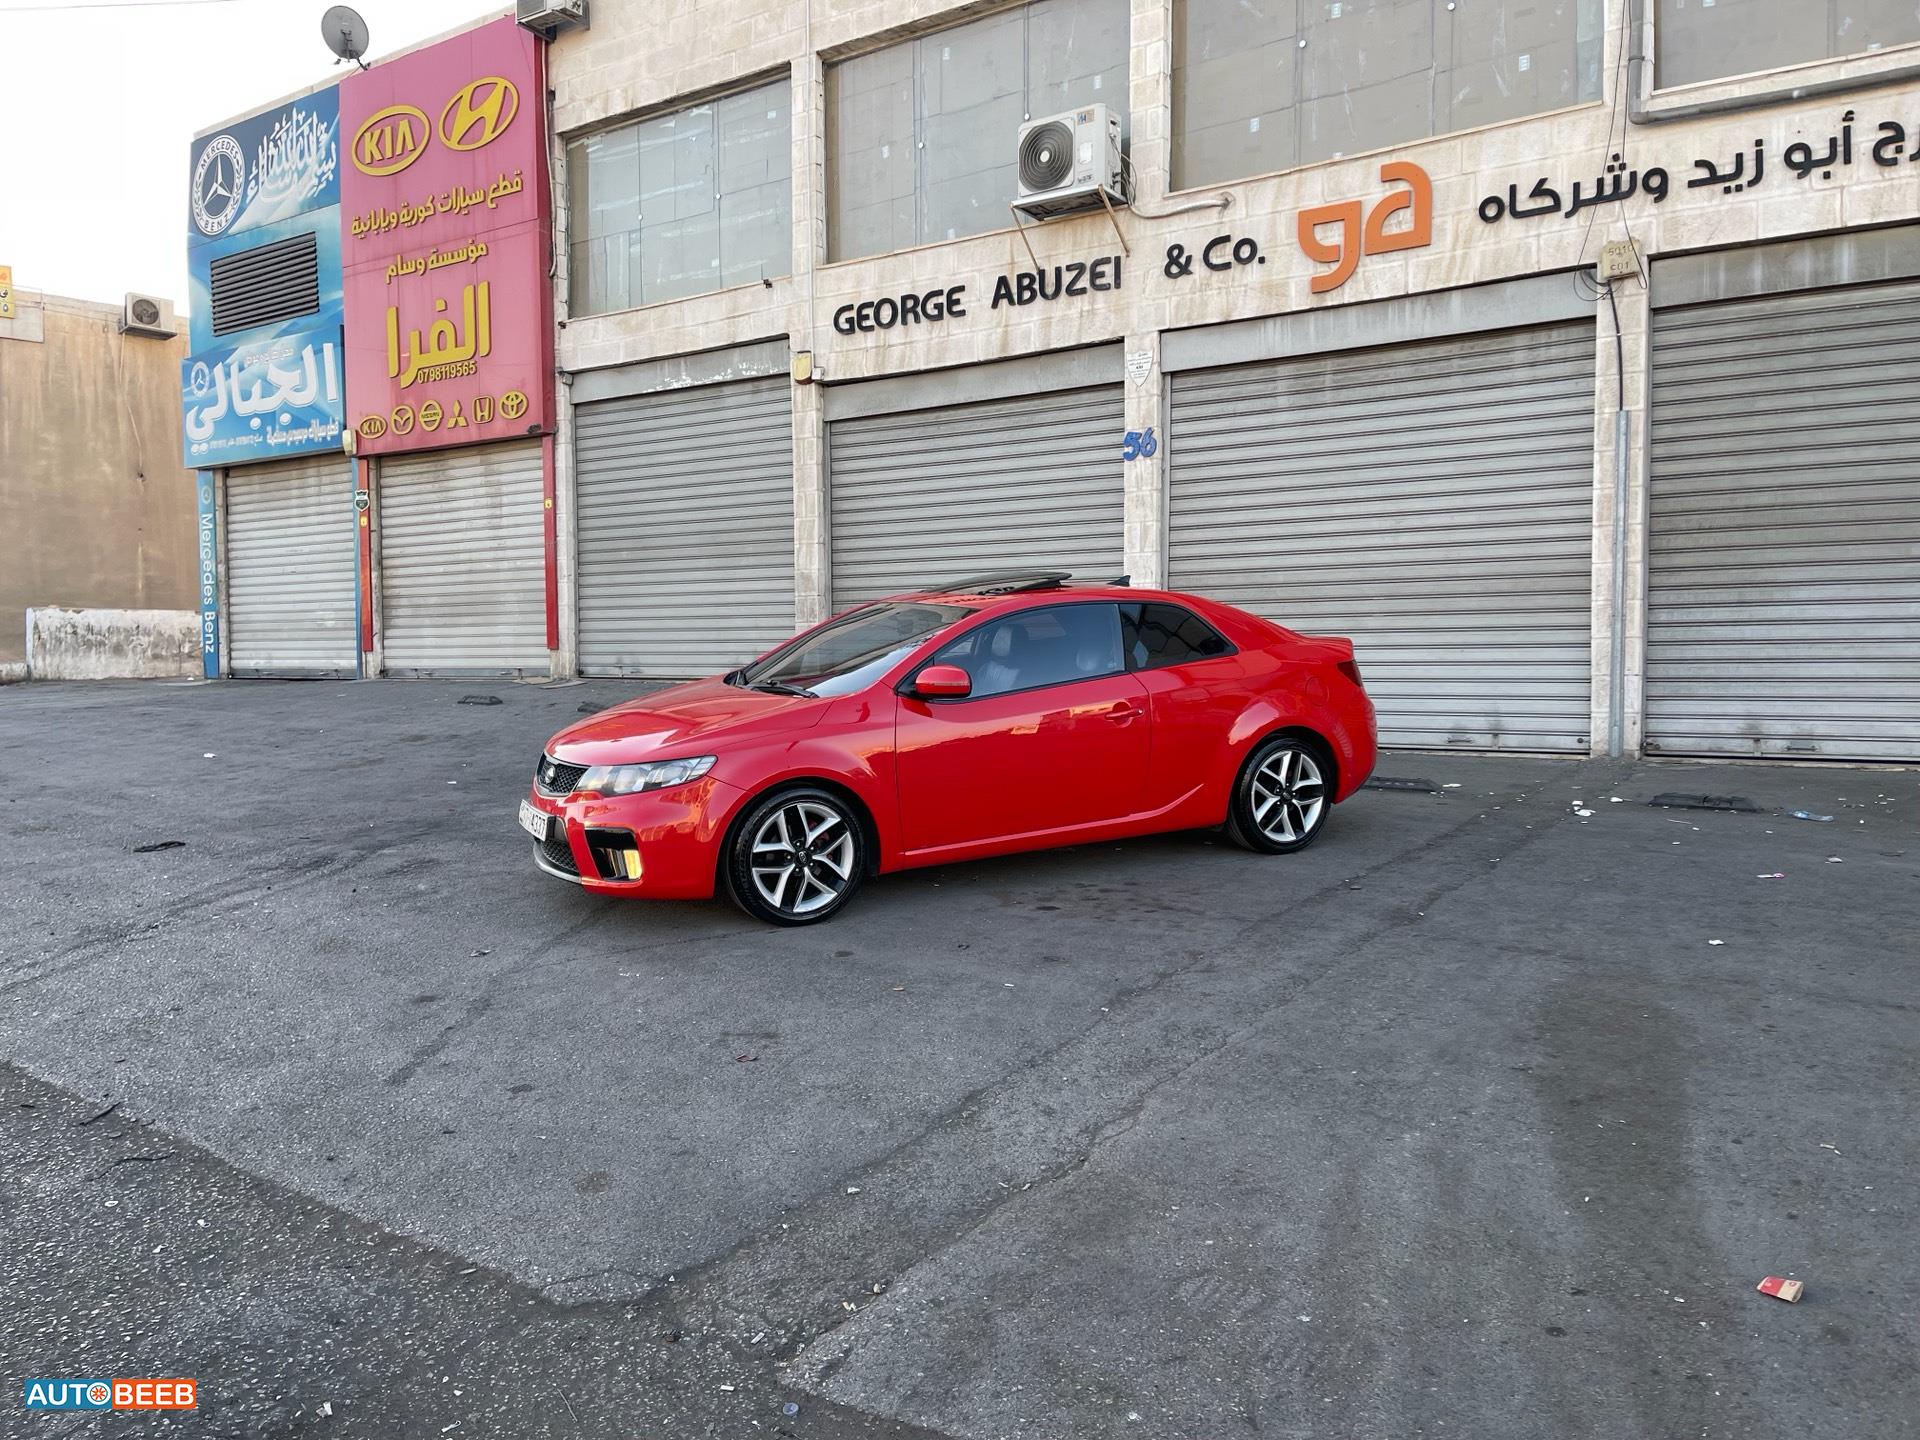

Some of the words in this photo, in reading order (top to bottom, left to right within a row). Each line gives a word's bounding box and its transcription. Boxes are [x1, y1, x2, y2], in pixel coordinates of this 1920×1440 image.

[200, 139, 239, 171] MERCEDES
[363, 126, 416, 165] KIA
[1784, 110, 1855, 179] أبو
[1687, 138, 1764, 195] زيد
[438, 186, 485, 215] سيارات
[487, 169, 523, 209] قطع
[1478, 153, 1669, 224] وشركاه
[204, 214, 229, 232] BENZ
[351, 207, 399, 239] ويابانية
[400, 195, 435, 228] كورية
[1297, 161, 1433, 294] ga
[386, 254, 427, 285] وسام
[428, 239, 488, 270] مؤسسة
[833, 284, 967, 336] GEORGE
[990, 255, 1122, 310] ABUZEI
[1164, 243, 1193, 279] &
[1202, 234, 1266, 272] Co.
[385, 281, 490, 390] الفرا
[417, 360, 478, 384] 0798119565
[185, 342, 339, 456] الجبالي
[362, 420, 383, 435] KIA
[1122, 427, 1157, 461] 56
[201, 513, 215, 605] Mercedes
[204, 611, 216, 654] Benz
